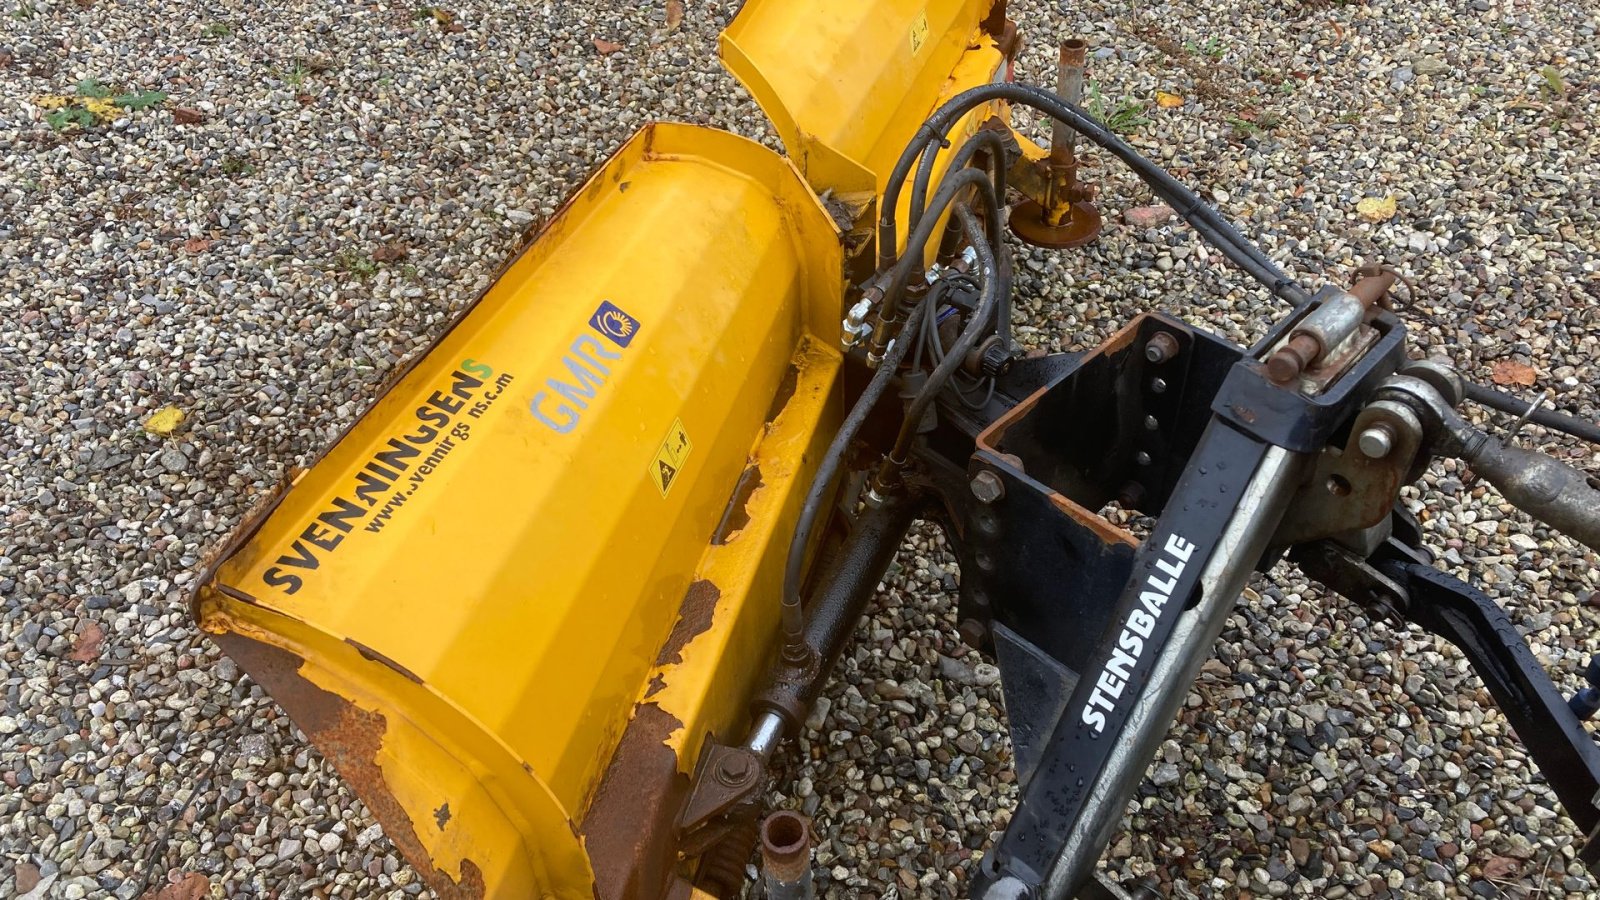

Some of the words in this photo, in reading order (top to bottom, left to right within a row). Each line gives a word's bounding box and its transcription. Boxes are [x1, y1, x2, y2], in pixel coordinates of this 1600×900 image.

[364, 372, 514, 533] www.venningsns.cm
[529, 333, 621, 434] GMR
[263, 358, 493, 595] SVENNINGSENS
[1082, 533, 1195, 733] STENSBALLE
